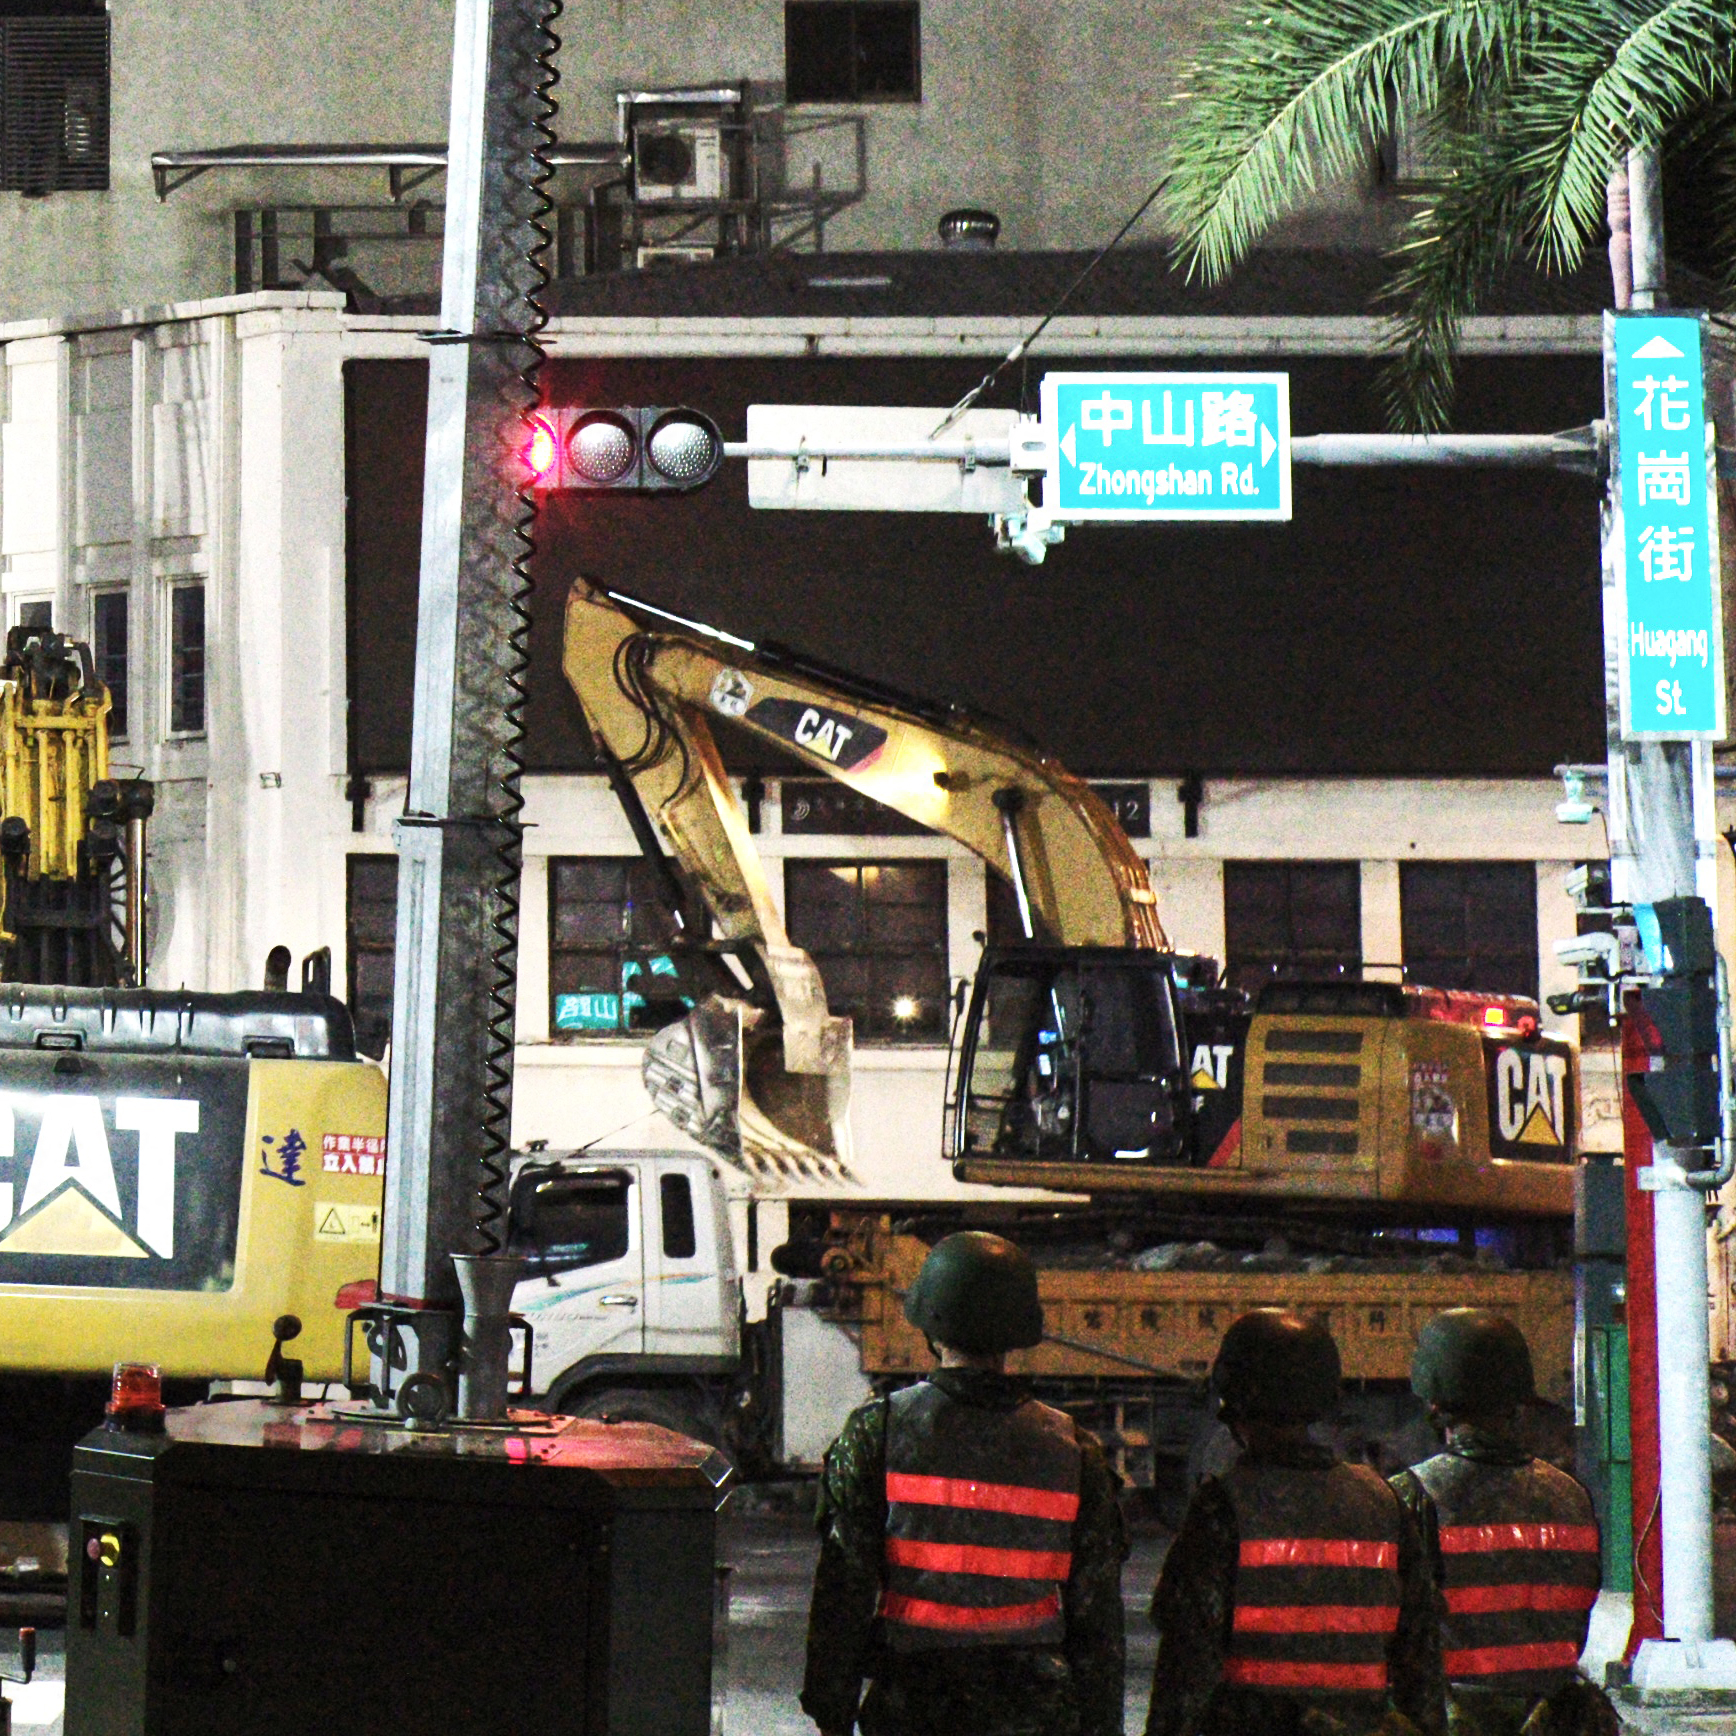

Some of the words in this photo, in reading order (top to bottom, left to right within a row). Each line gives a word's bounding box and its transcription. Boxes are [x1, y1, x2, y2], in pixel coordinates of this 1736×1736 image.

[1081, 390, 1258, 447] 中山路
[1079, 462, 1213, 505] Zhongshan
[1221, 462, 1260, 495] Rd.
[1632, 374, 1695, 583] 花崗街
[1630, 621, 1708, 668] Huagang
[794, 708, 854, 761] CAT
[1190, 1044, 1234, 1089] AT
[1496, 1048, 1568, 1146] CAT
[259, 1128, 306, 1187] 達
